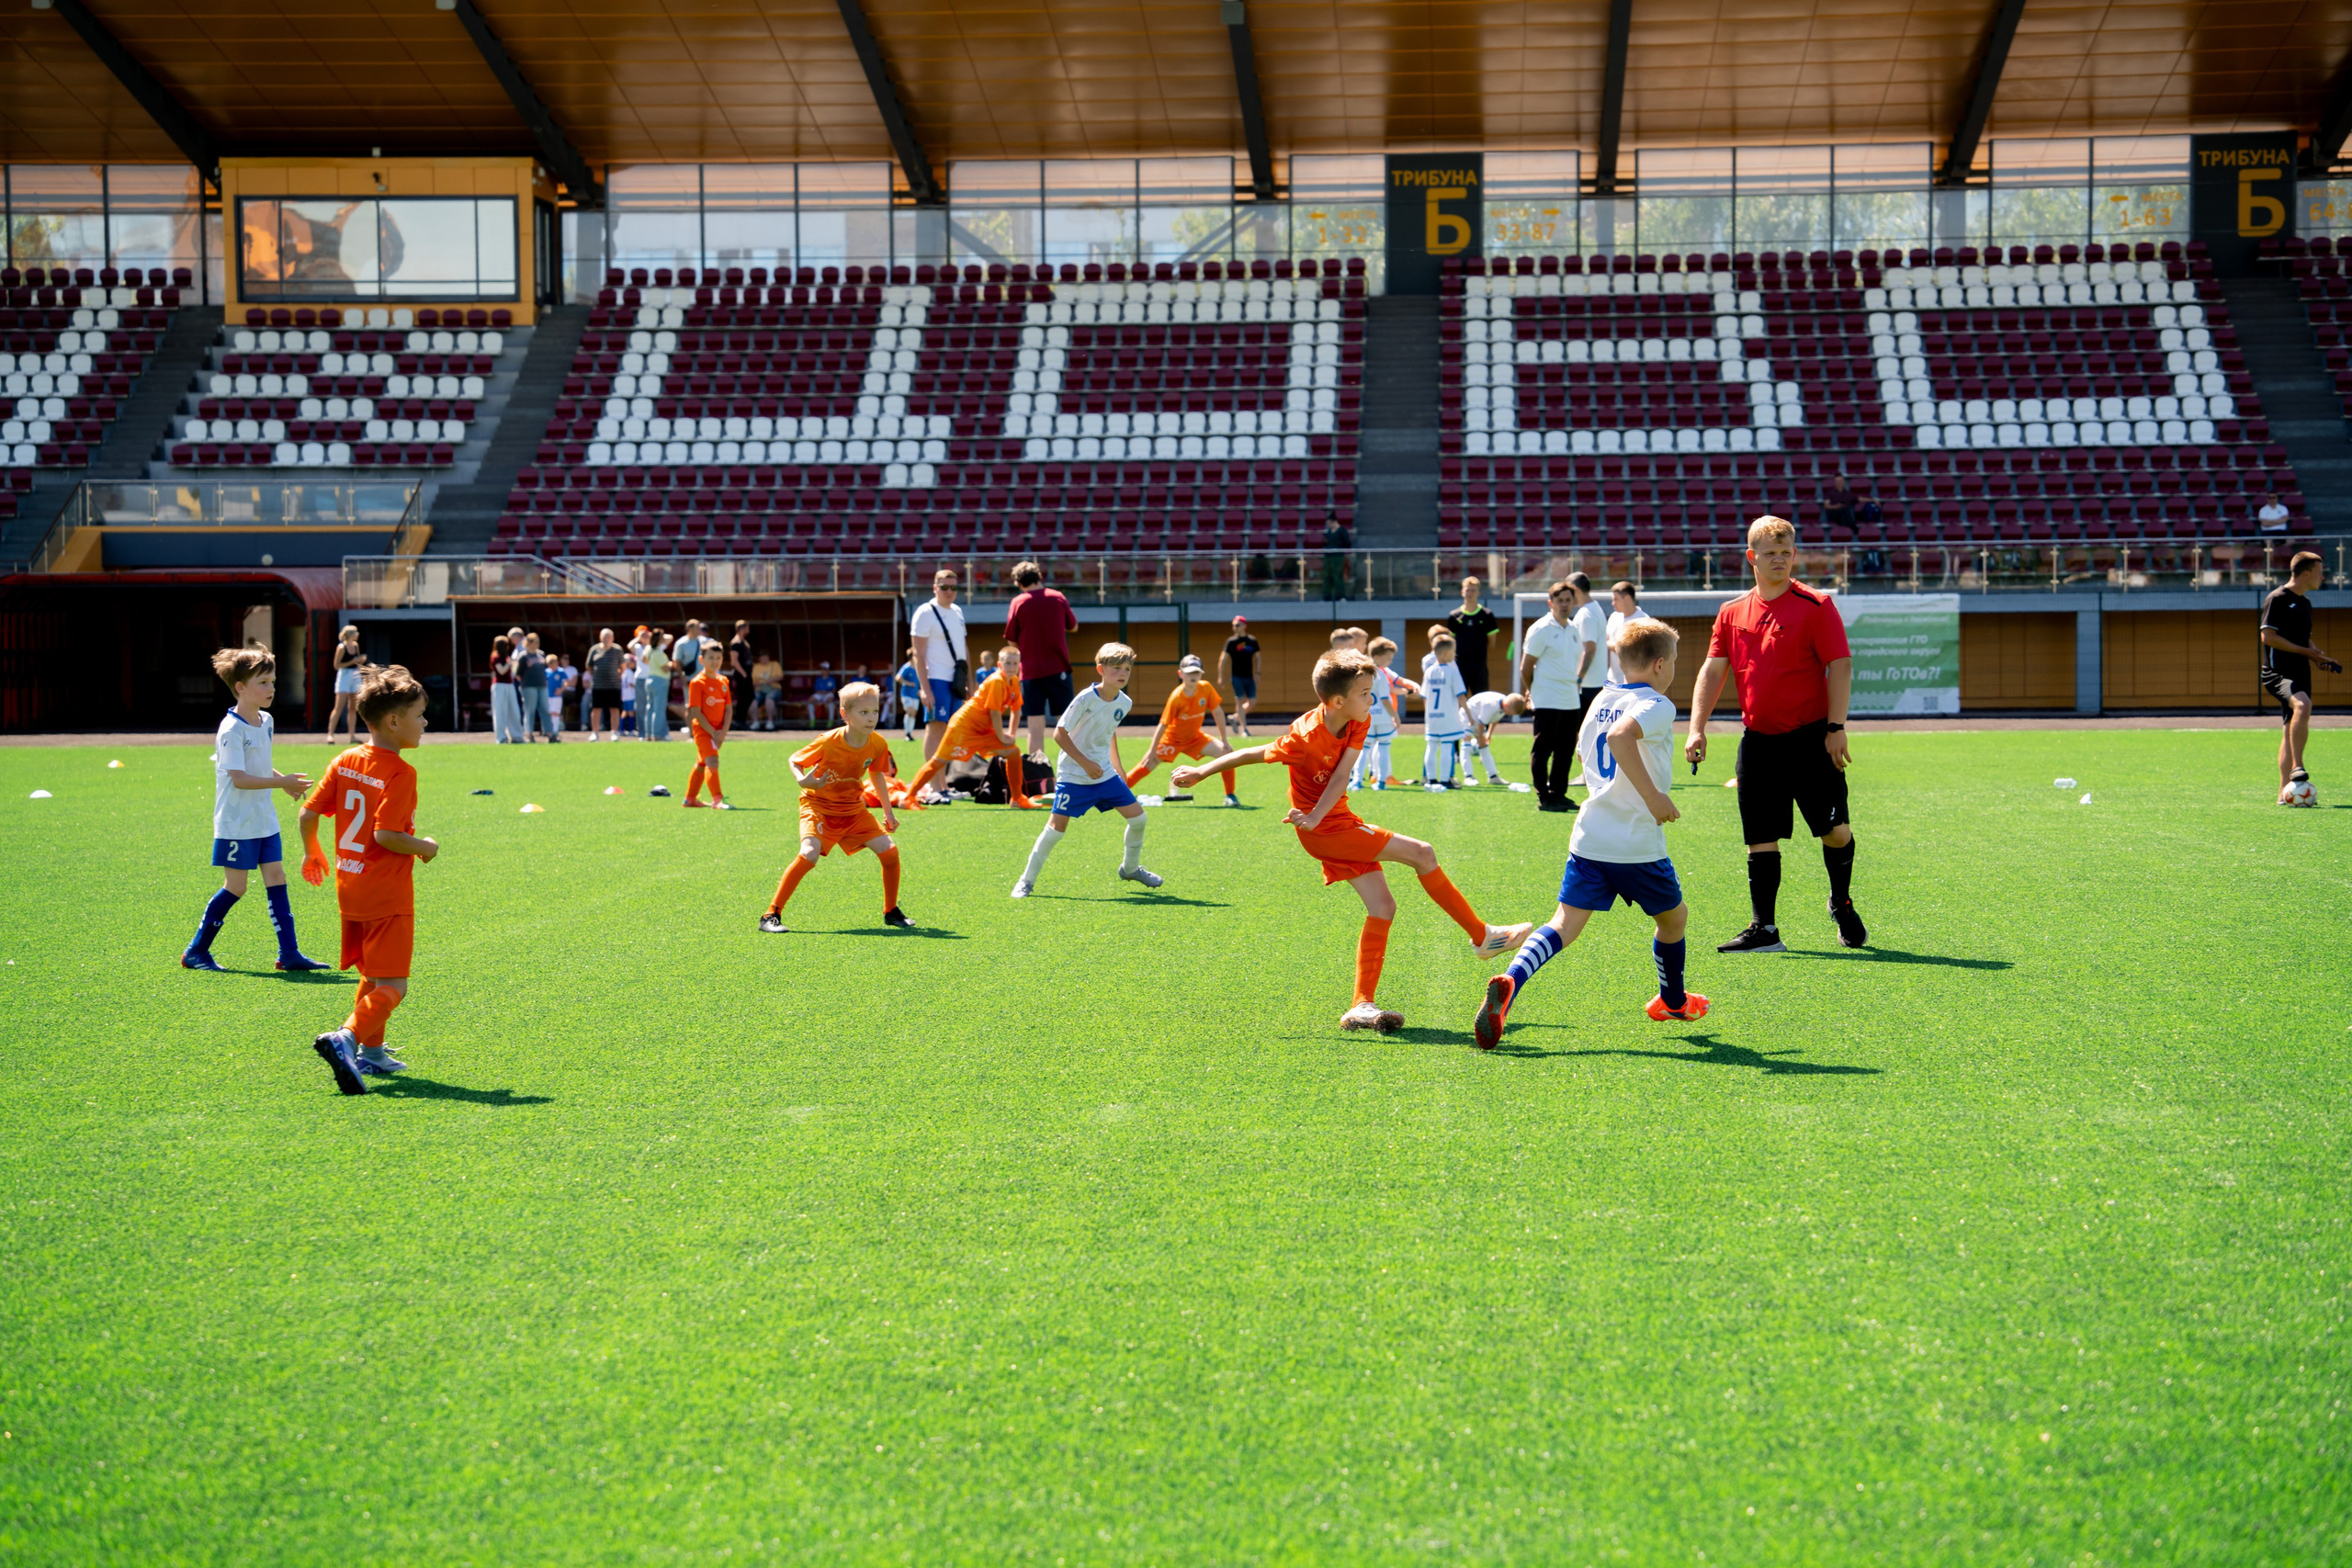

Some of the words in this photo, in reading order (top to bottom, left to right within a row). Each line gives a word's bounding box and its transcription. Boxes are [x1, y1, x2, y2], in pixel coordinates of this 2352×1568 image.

[2199, 149, 2290, 166] ТРИБУНА
[1391, 169, 1478, 186] ТРИБУНА
[2142, 192, 2183, 202] МЕСТА
[2304, 187, 2346, 198] МЕСТА
[2237, 168, 2285, 237] Б
[1338, 209, 1377, 220] МЕСТА
[1425, 186, 1471, 255] Б
[1490, 208, 1531, 219] МЕСТА
[2119, 209, 2172, 227] 1-63
[1317, 226, 1367, 243] 1-32
[1497, 223, 1556, 241] 33-87
[1909, 635, 1928, 644] ГТО
[1858, 671, 1883, 681] ты
[1886, 665, 1941, 681] ГоТОв?!
[1431, 688, 1441, 710] 7
[1056, 792, 1070, 811] 12
[339, 789, 366, 853] 2
[227, 840, 239, 863] 2
